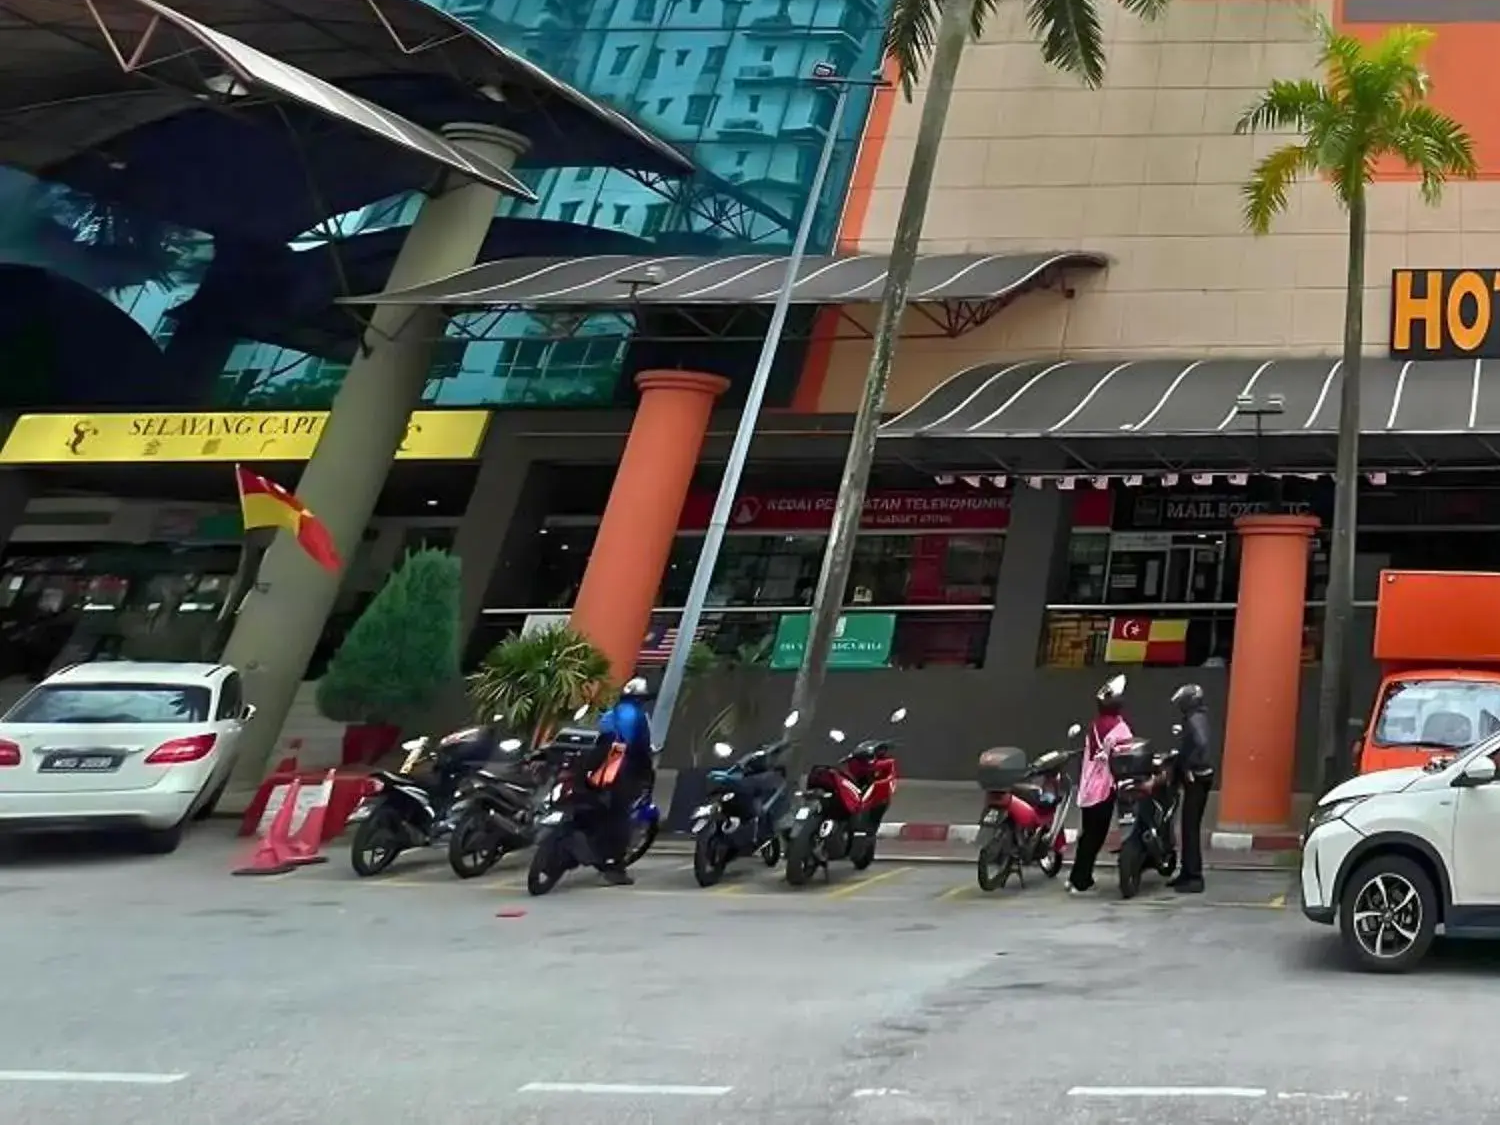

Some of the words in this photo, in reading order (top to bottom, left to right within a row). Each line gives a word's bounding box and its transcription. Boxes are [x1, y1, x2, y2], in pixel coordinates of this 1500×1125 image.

[129, 416, 252, 437] SELAYANG
[257, 416, 318, 436] CAPI
[1166, 502, 1215, 519] MAIL
